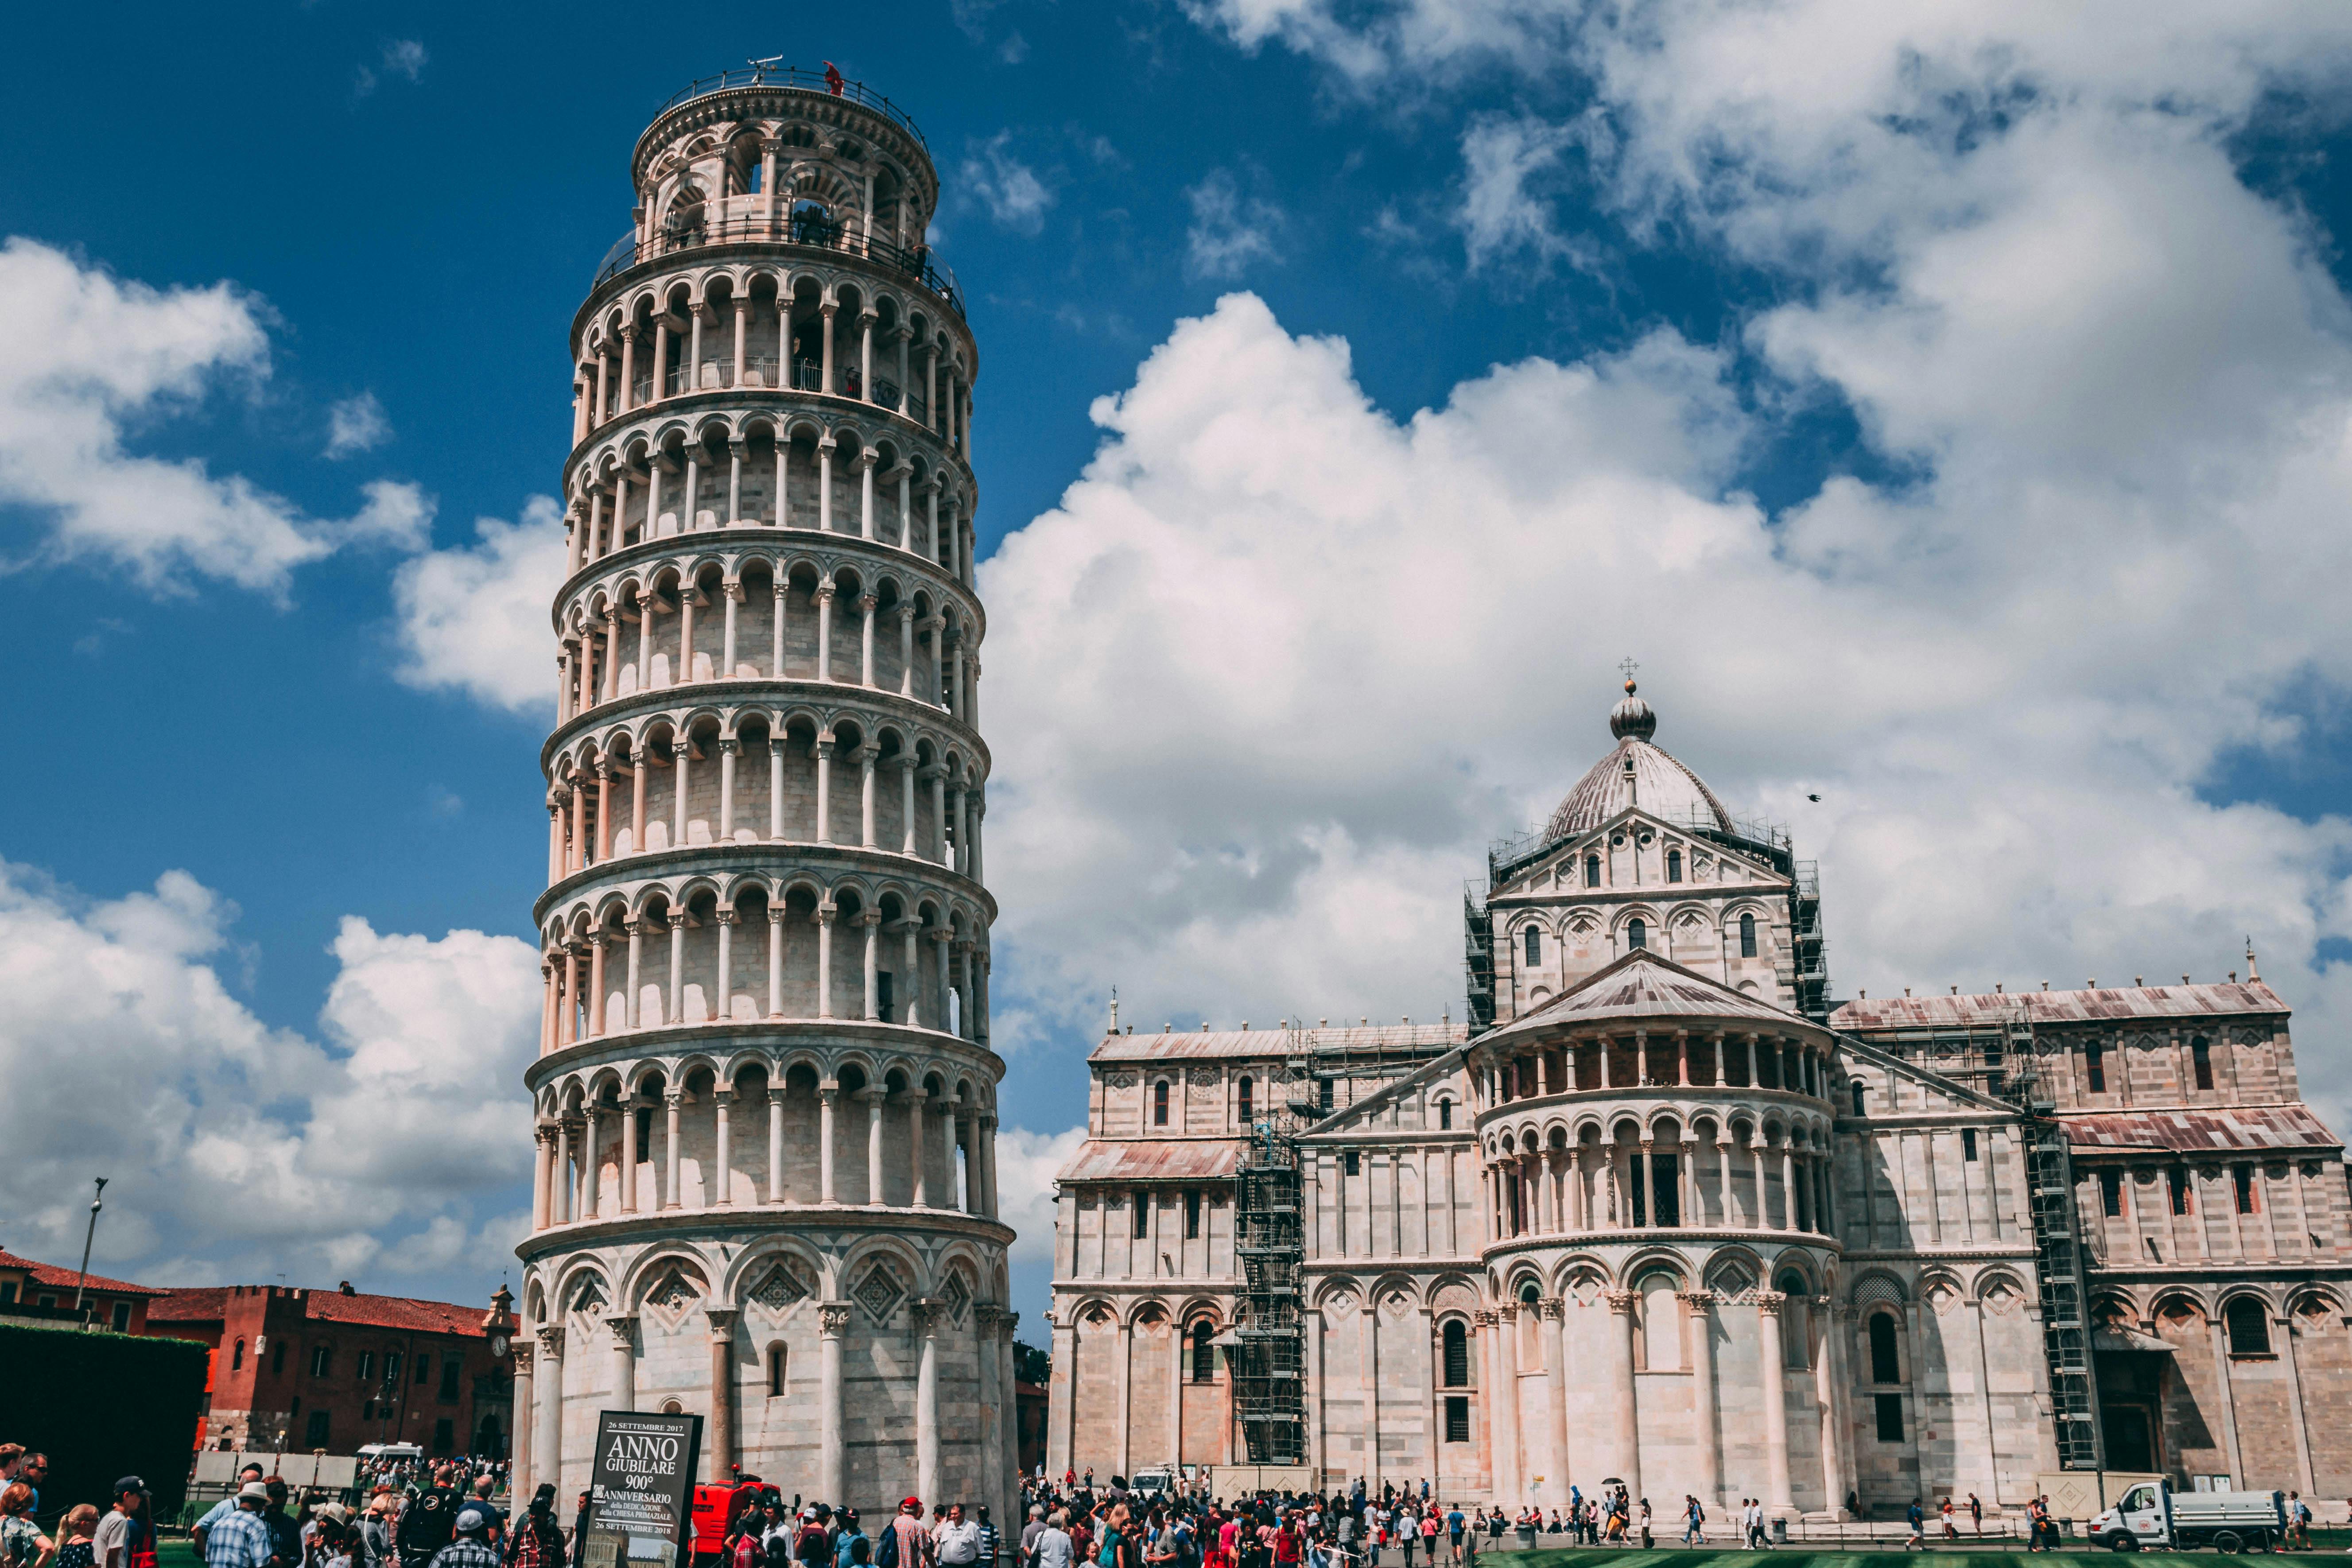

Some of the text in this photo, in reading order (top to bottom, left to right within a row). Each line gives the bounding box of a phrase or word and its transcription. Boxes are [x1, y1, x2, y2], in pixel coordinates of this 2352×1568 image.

[607, 1435, 678, 1461] ANNO
[606, 1458, 675, 1475] GIUBILARE
[625, 1475, 653, 1490] 900°
[603, 1490, 671, 1504] ANNIVERSARIO
[623, 1503, 661, 1512] DEDICAZIONE
[635, 1511, 671, 1521] PRIMAZIALE
[606, 1523, 652, 1533] SETTEMBRE
